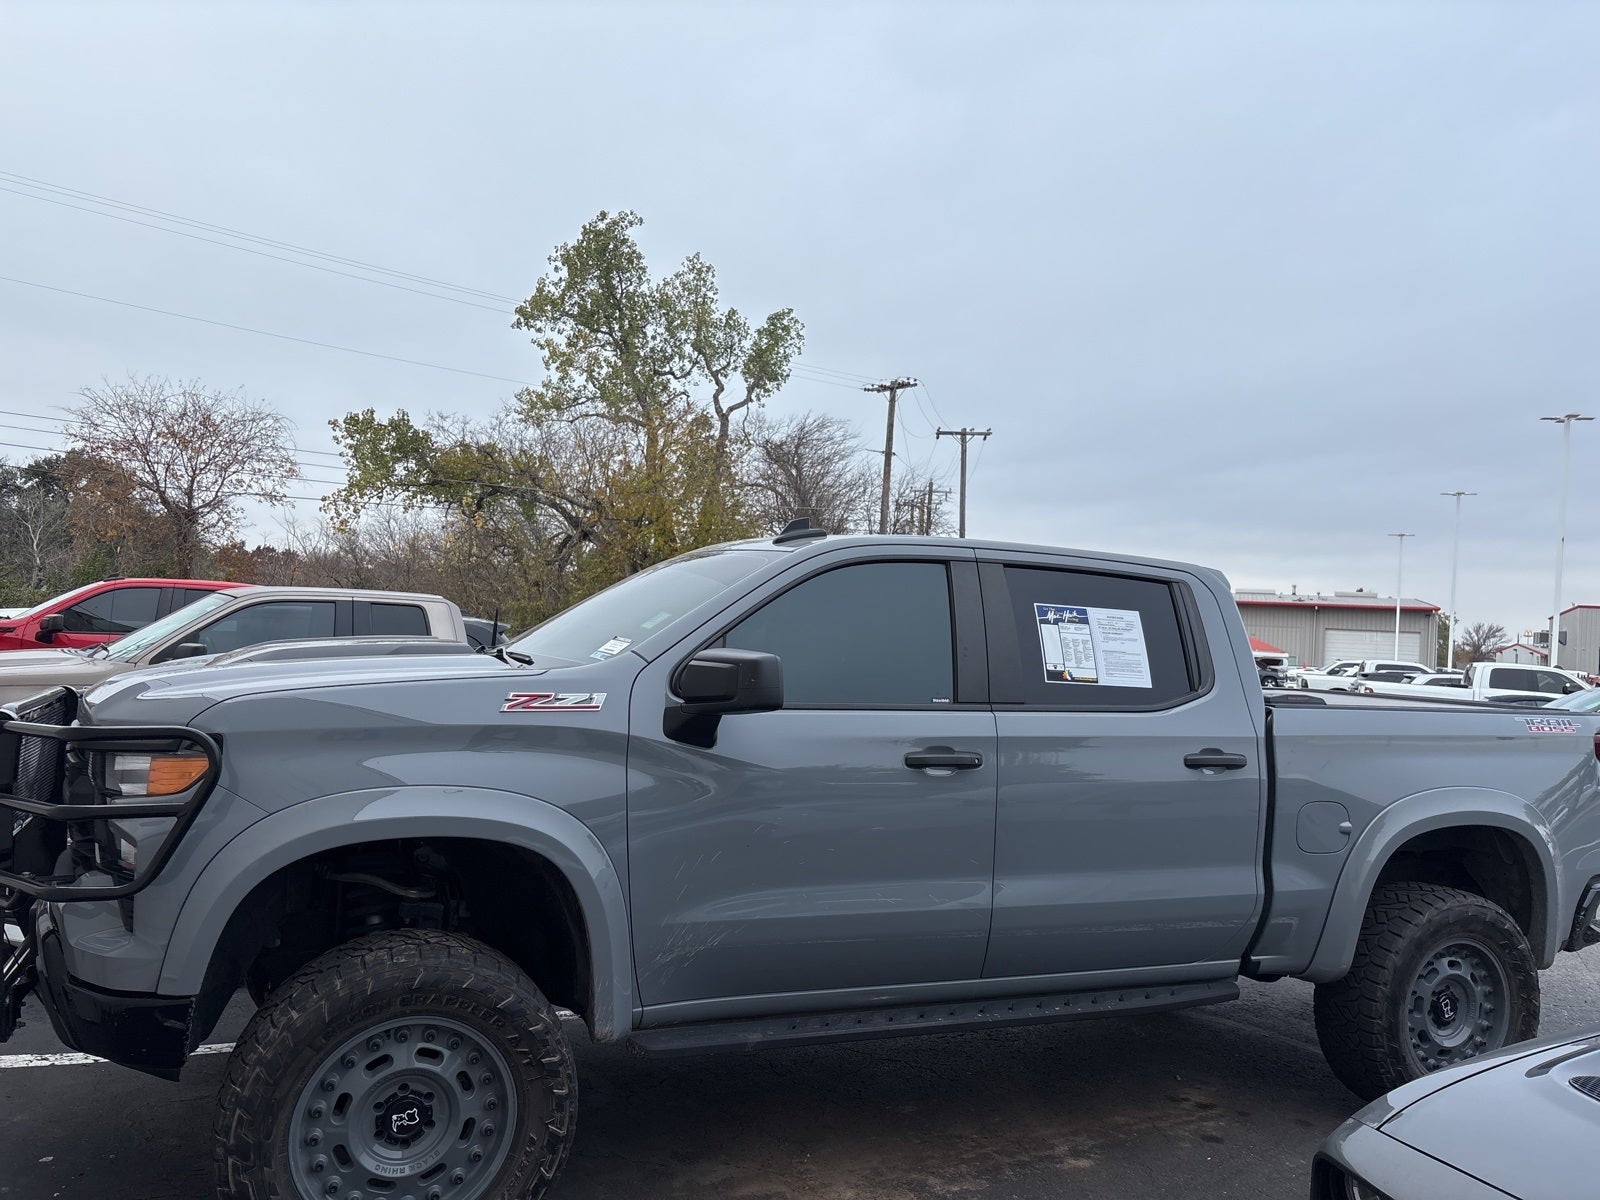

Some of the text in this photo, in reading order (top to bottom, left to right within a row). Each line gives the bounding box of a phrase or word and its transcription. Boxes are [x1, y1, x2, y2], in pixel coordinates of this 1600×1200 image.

[499, 691, 608, 712] Z71
[1514, 716, 1582, 727] TRAIL
[1527, 725, 1577, 733] BOSS
[374, 1149, 441, 1175] BLACK RHINO
